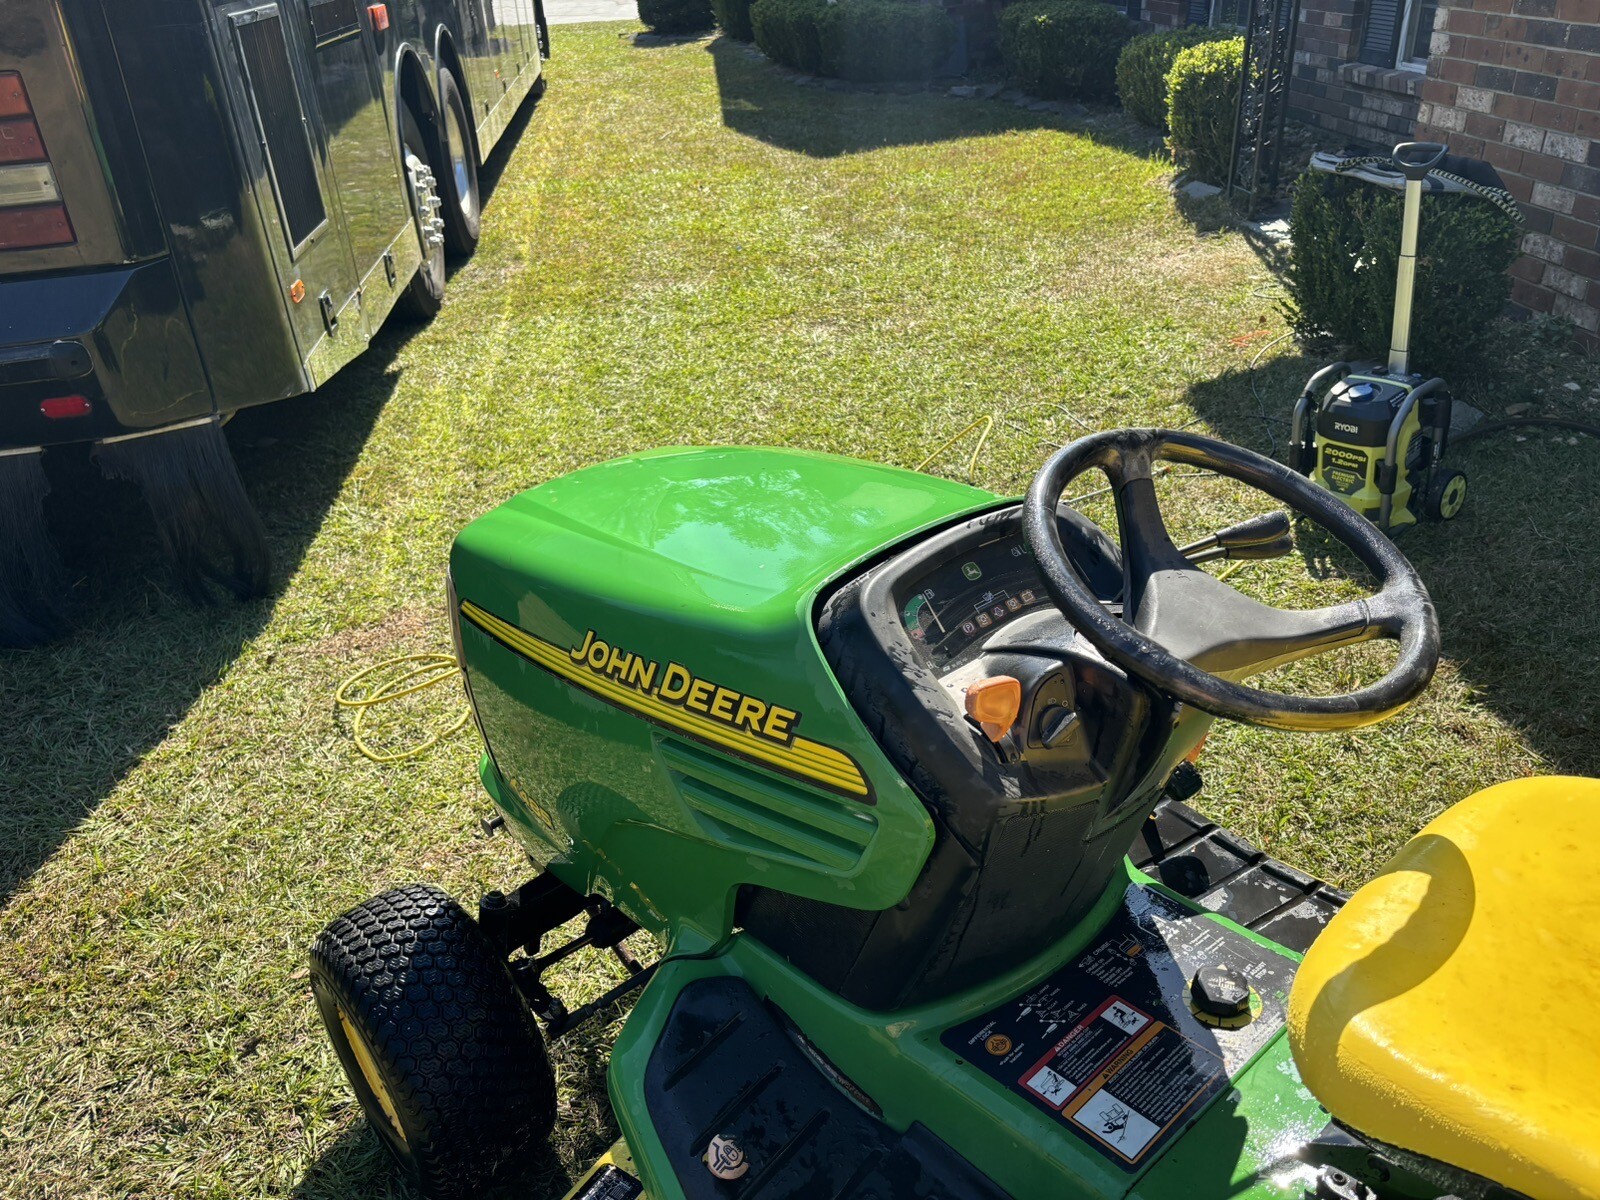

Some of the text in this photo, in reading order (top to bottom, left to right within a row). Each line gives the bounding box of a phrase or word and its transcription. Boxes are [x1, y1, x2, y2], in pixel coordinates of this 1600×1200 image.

[1334, 421, 1358, 434] RYOBI
[570, 628, 800, 745] JOHN DEERE
[1057, 1024, 1085, 1048] DANGER
[1106, 1049, 1133, 1074] WARNING
